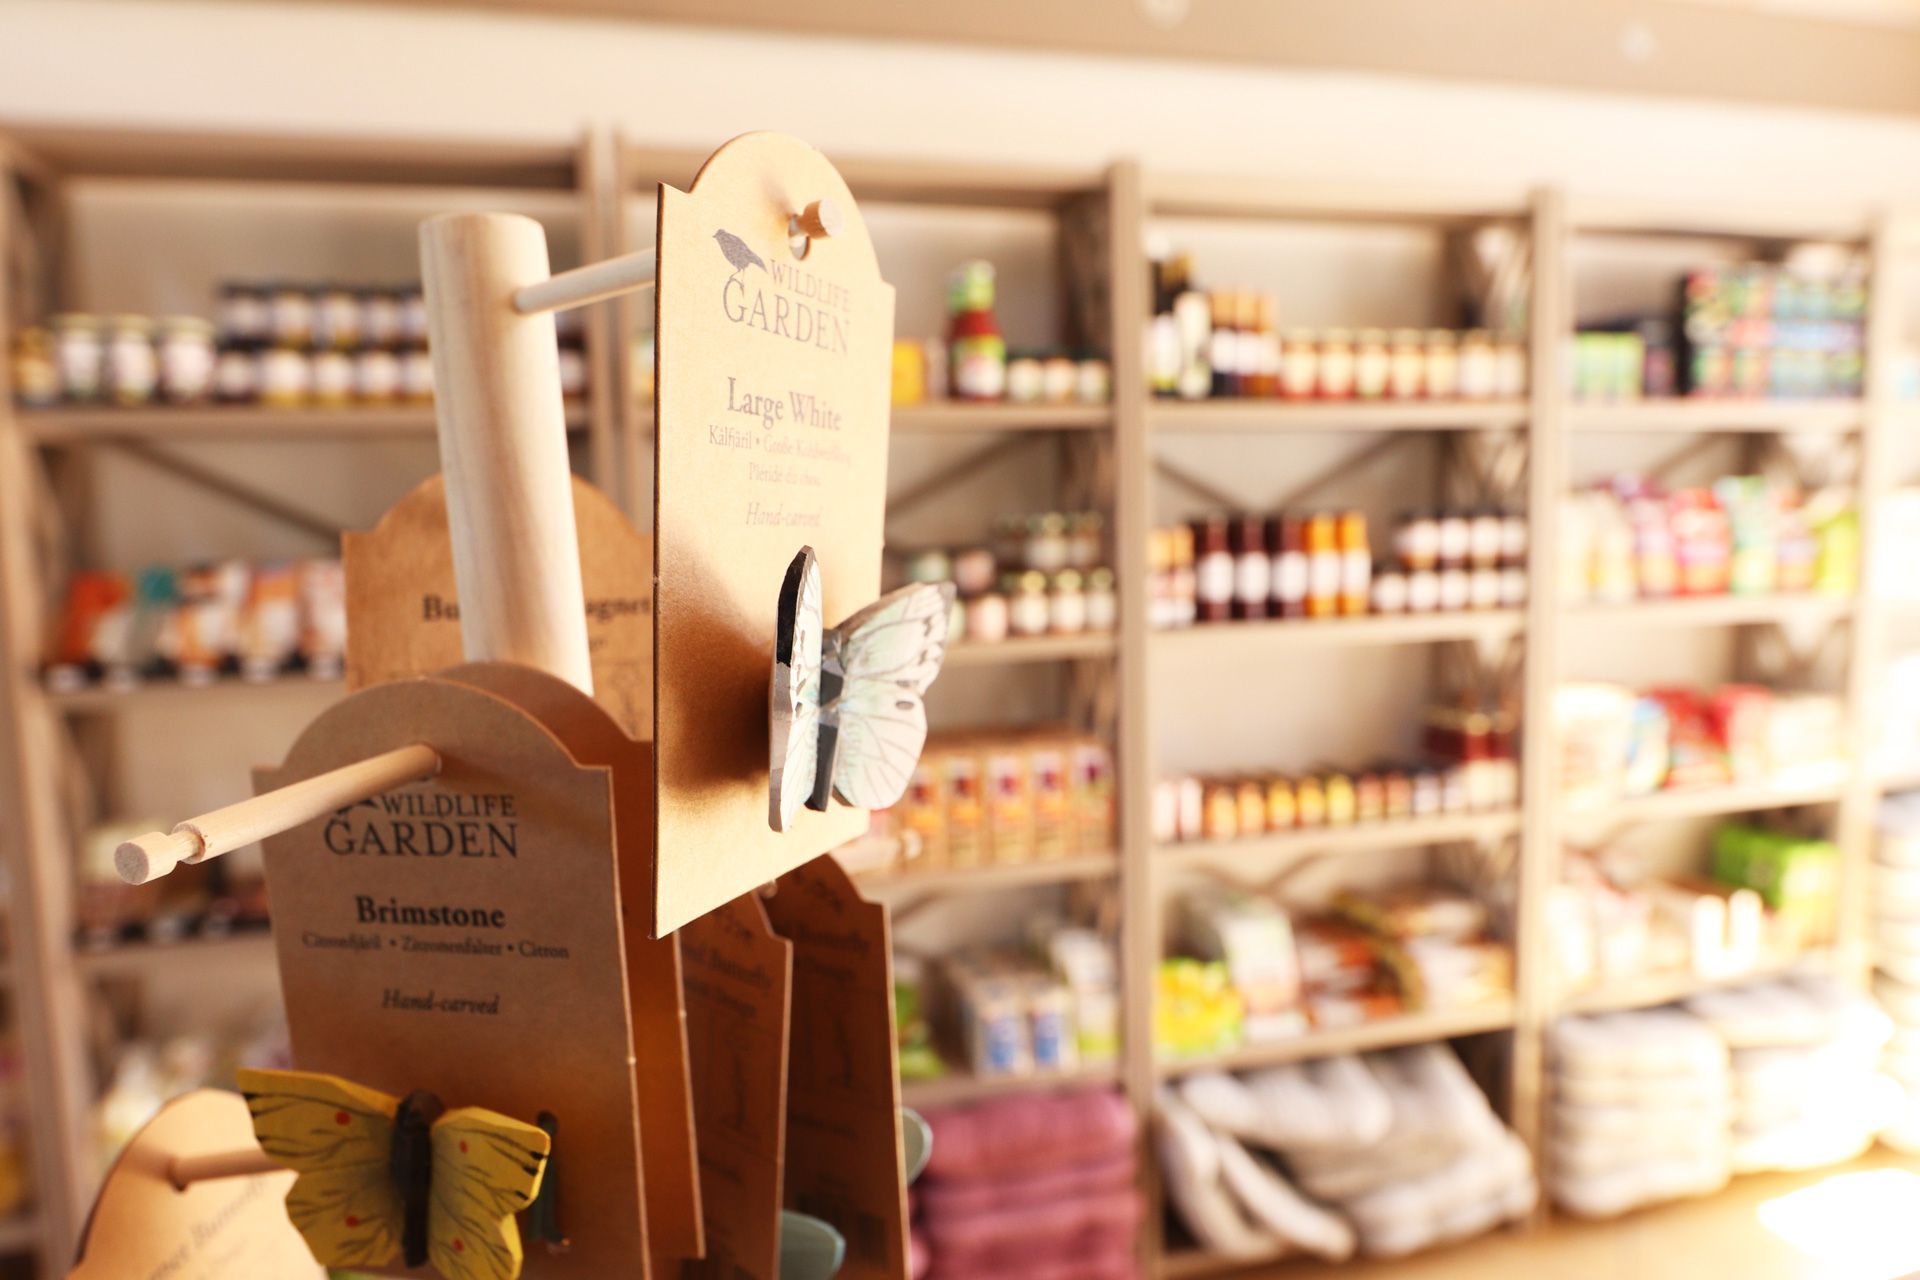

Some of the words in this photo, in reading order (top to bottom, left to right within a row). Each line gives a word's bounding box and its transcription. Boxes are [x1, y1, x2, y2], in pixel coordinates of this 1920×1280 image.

[769, 259, 850, 313] WILDLIFE
[723, 278, 850, 355] GARDEN
[727, 376, 784, 430] Large
[788, 391, 843, 432] White
[745, 501, 823, 528] Hand-carved
[585, 598, 650, 621] agnet
[379, 793, 517, 819] WILDLIFE
[324, 818, 518, 859] GARDEN
[356, 895, 507, 929] Brimstone
[518, 940, 570, 960] Citron
[383, 988, 500, 1017] Hand-carved
